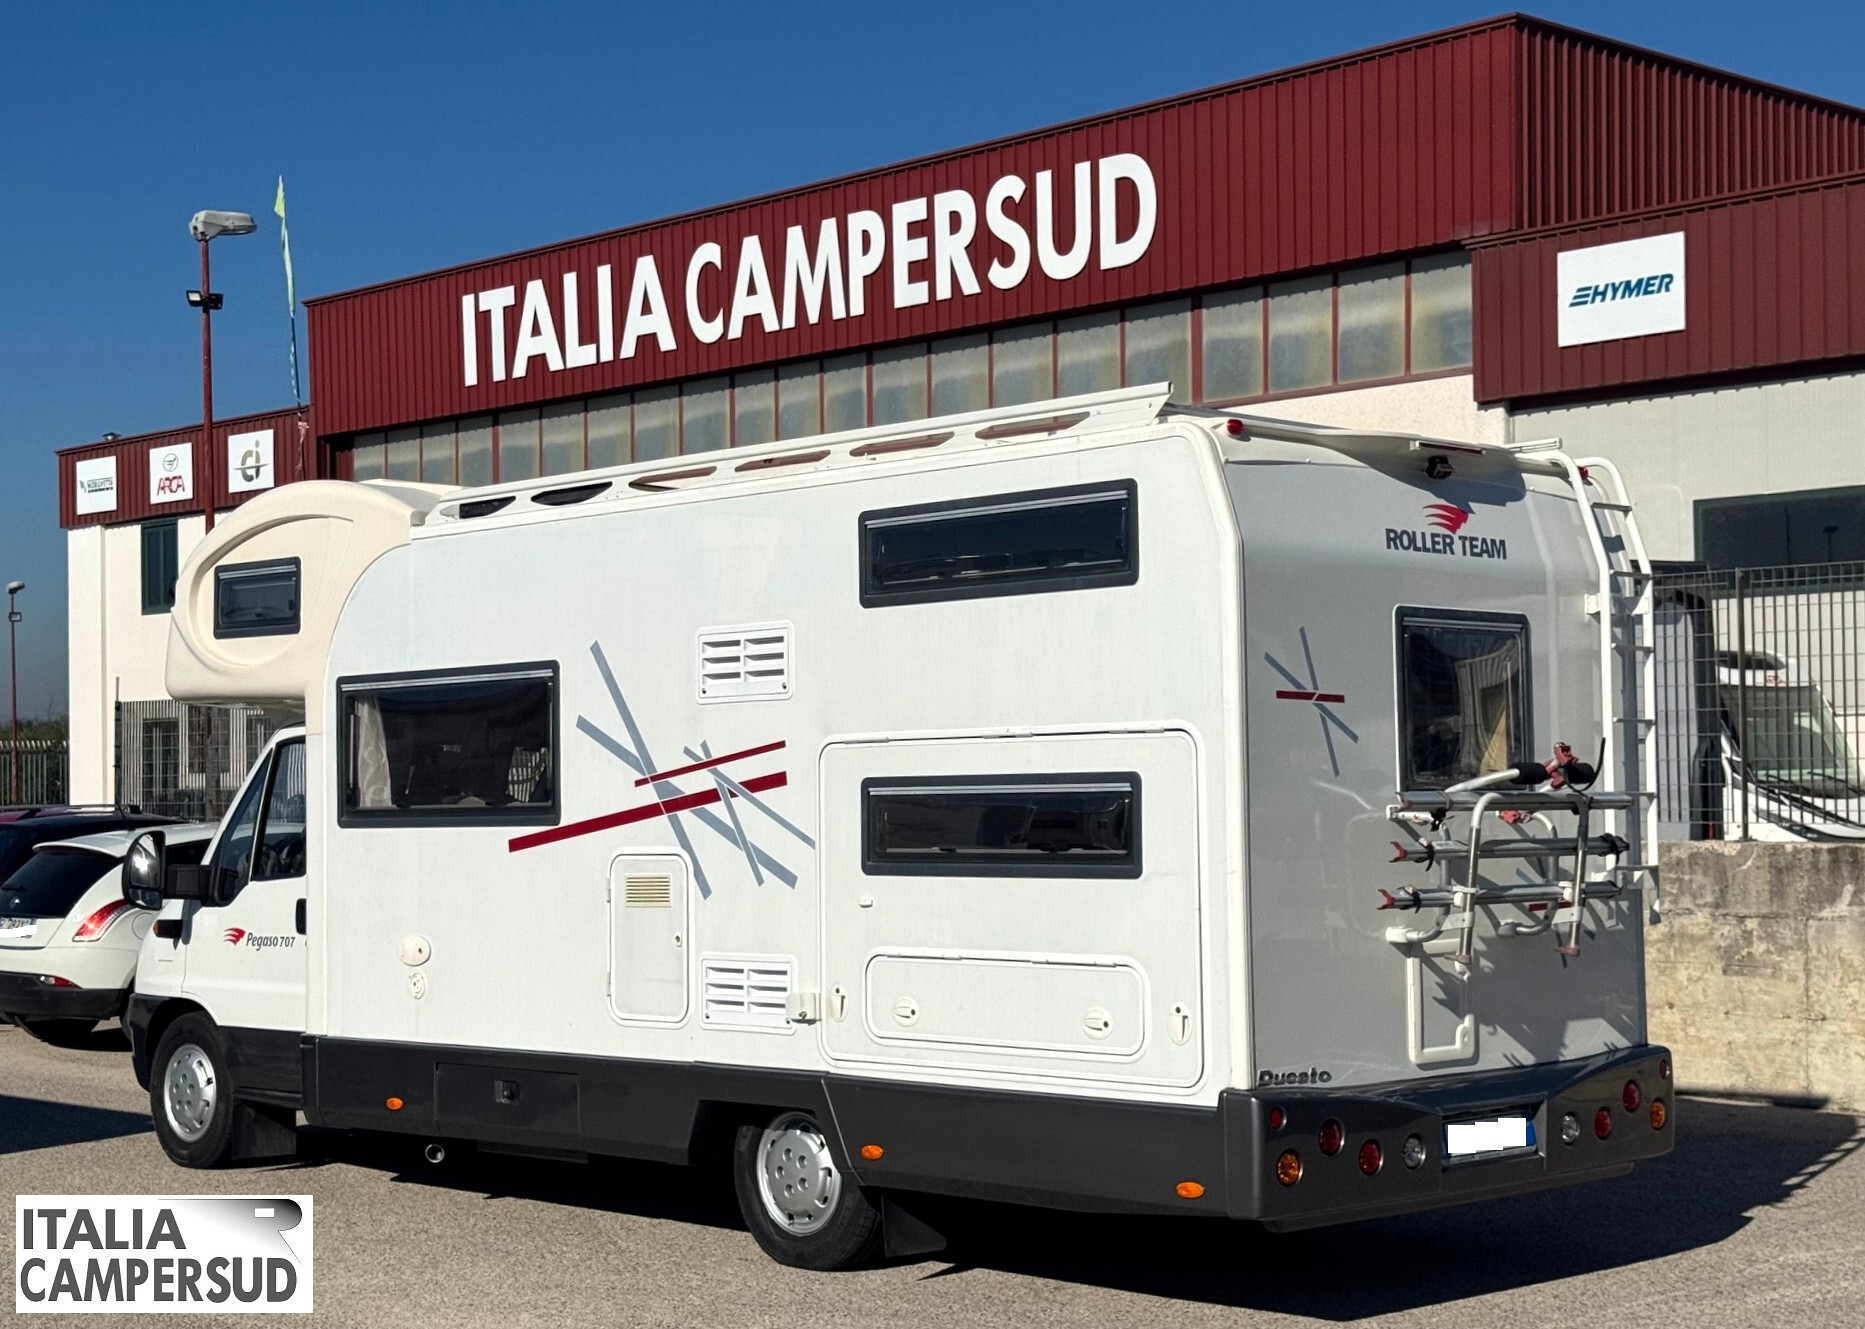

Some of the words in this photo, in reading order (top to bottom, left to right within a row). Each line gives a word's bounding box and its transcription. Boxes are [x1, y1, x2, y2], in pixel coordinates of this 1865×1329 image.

[462, 254, 678, 387] ITALIA
[685, 152, 1158, 344] CAMPERSUD
[1589, 273, 1674, 305] HYMER
[157, 475, 185, 496] ARCA
[1385, 528, 1456, 556] ROLLER
[1458, 535, 1508, 560] TEAM
[245, 932, 279, 952] Pegaso
[279, 936, 296, 948] 707
[1257, 1067, 1332, 1087] Ducato
